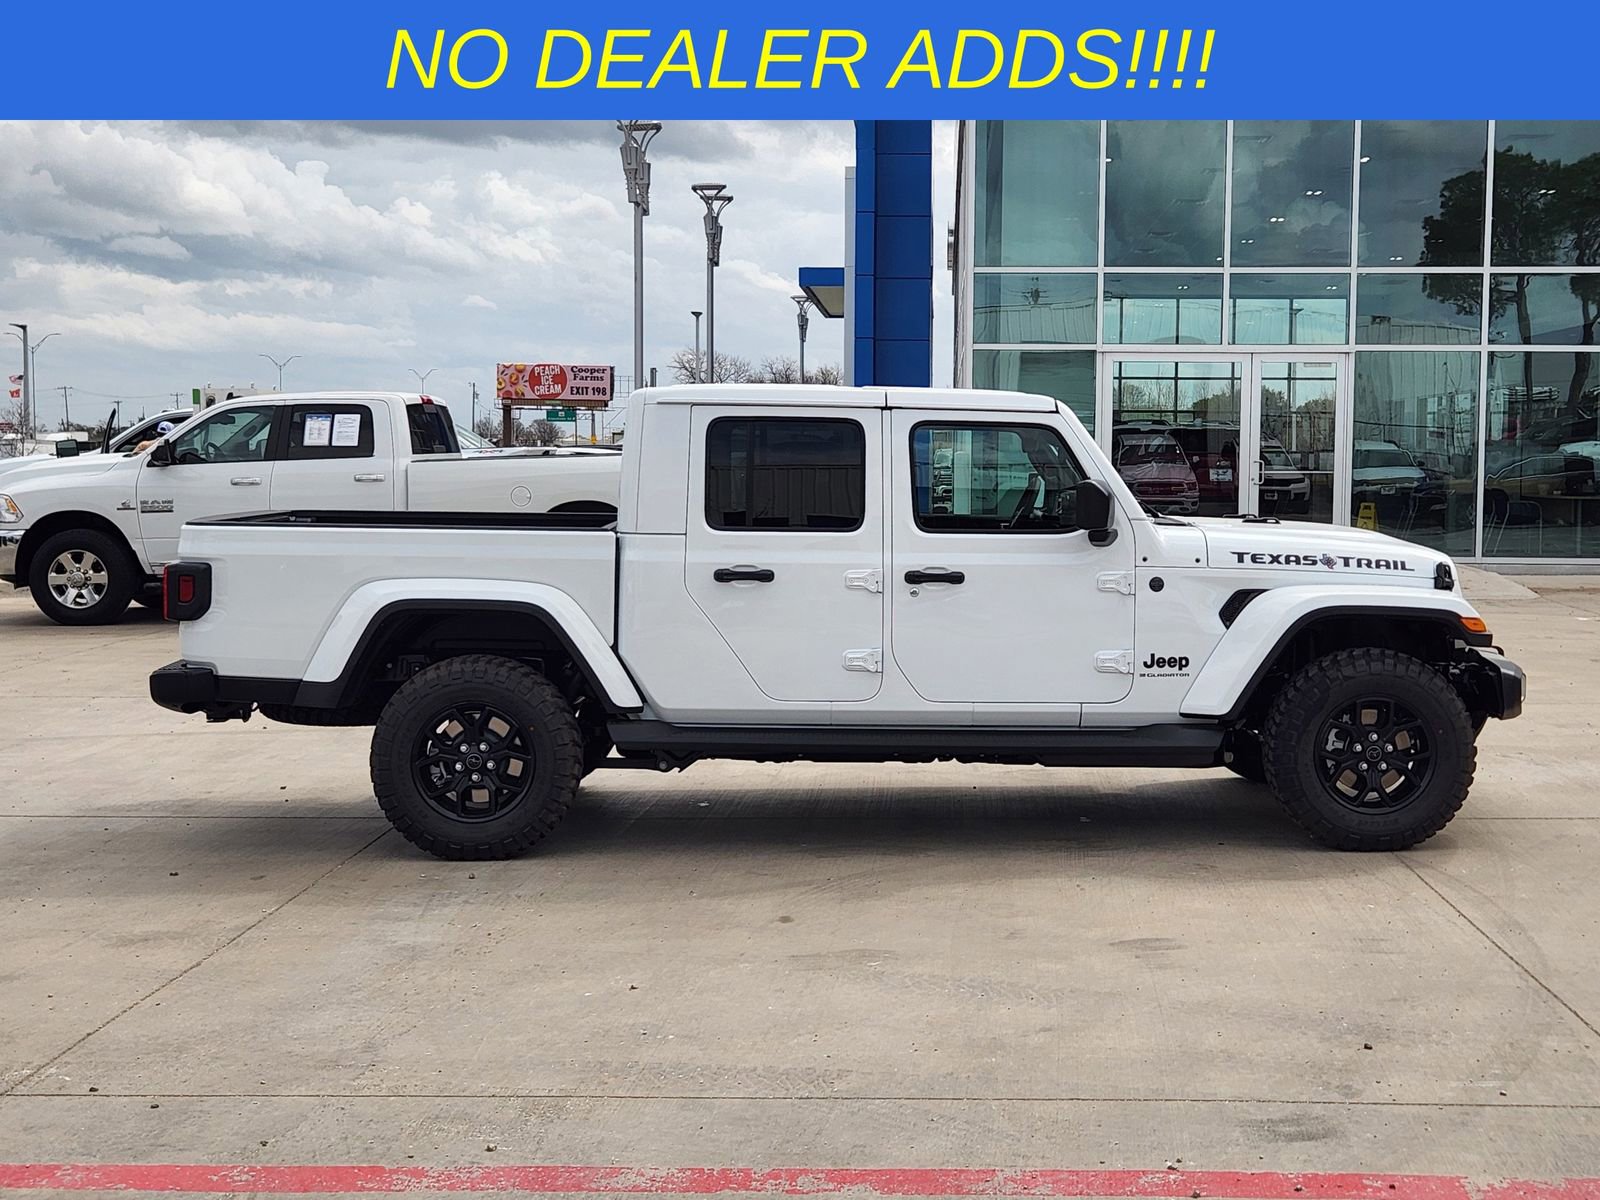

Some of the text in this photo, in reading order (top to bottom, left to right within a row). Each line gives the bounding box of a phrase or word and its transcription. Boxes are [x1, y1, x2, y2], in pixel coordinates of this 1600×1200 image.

[534, 366, 560, 376] PEACH
[571, 366, 607, 375] Cooper
[541, 375, 553, 385] ICE
[573, 374, 604, 382] Farms
[534, 384, 562, 396] CREAM
[570, 386, 607, 396] EXIT 198
[1230, 551, 1415, 572] TEXAS TRAIL
[1143, 653, 1190, 671] Jeep
